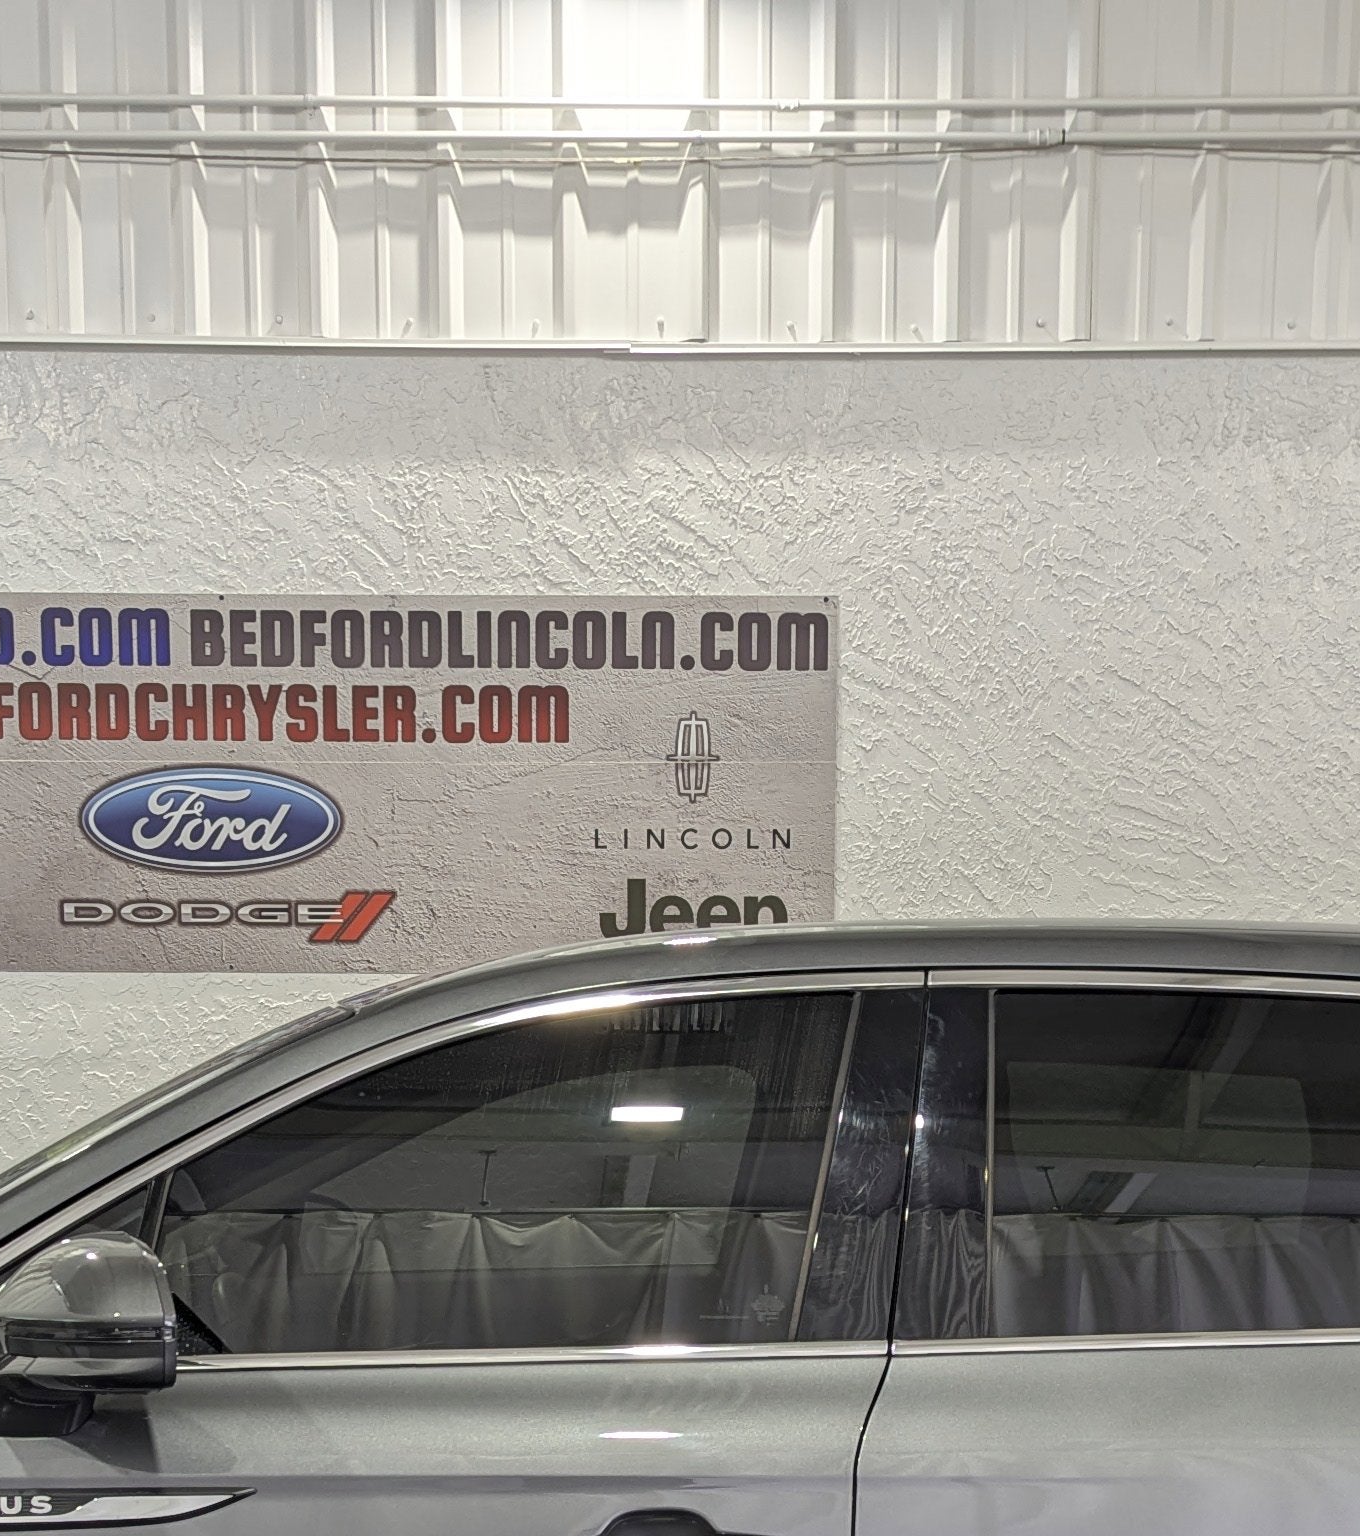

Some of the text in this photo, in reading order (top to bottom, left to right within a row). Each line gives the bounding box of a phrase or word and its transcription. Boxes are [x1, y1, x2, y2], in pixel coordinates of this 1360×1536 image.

[190, 608, 828, 671] BEDFORDLINCOLN.COM
[131, 784, 292, 851] Ford
[594, 828, 791, 850] LINCOLN
[61, 900, 344, 925] DODGE
